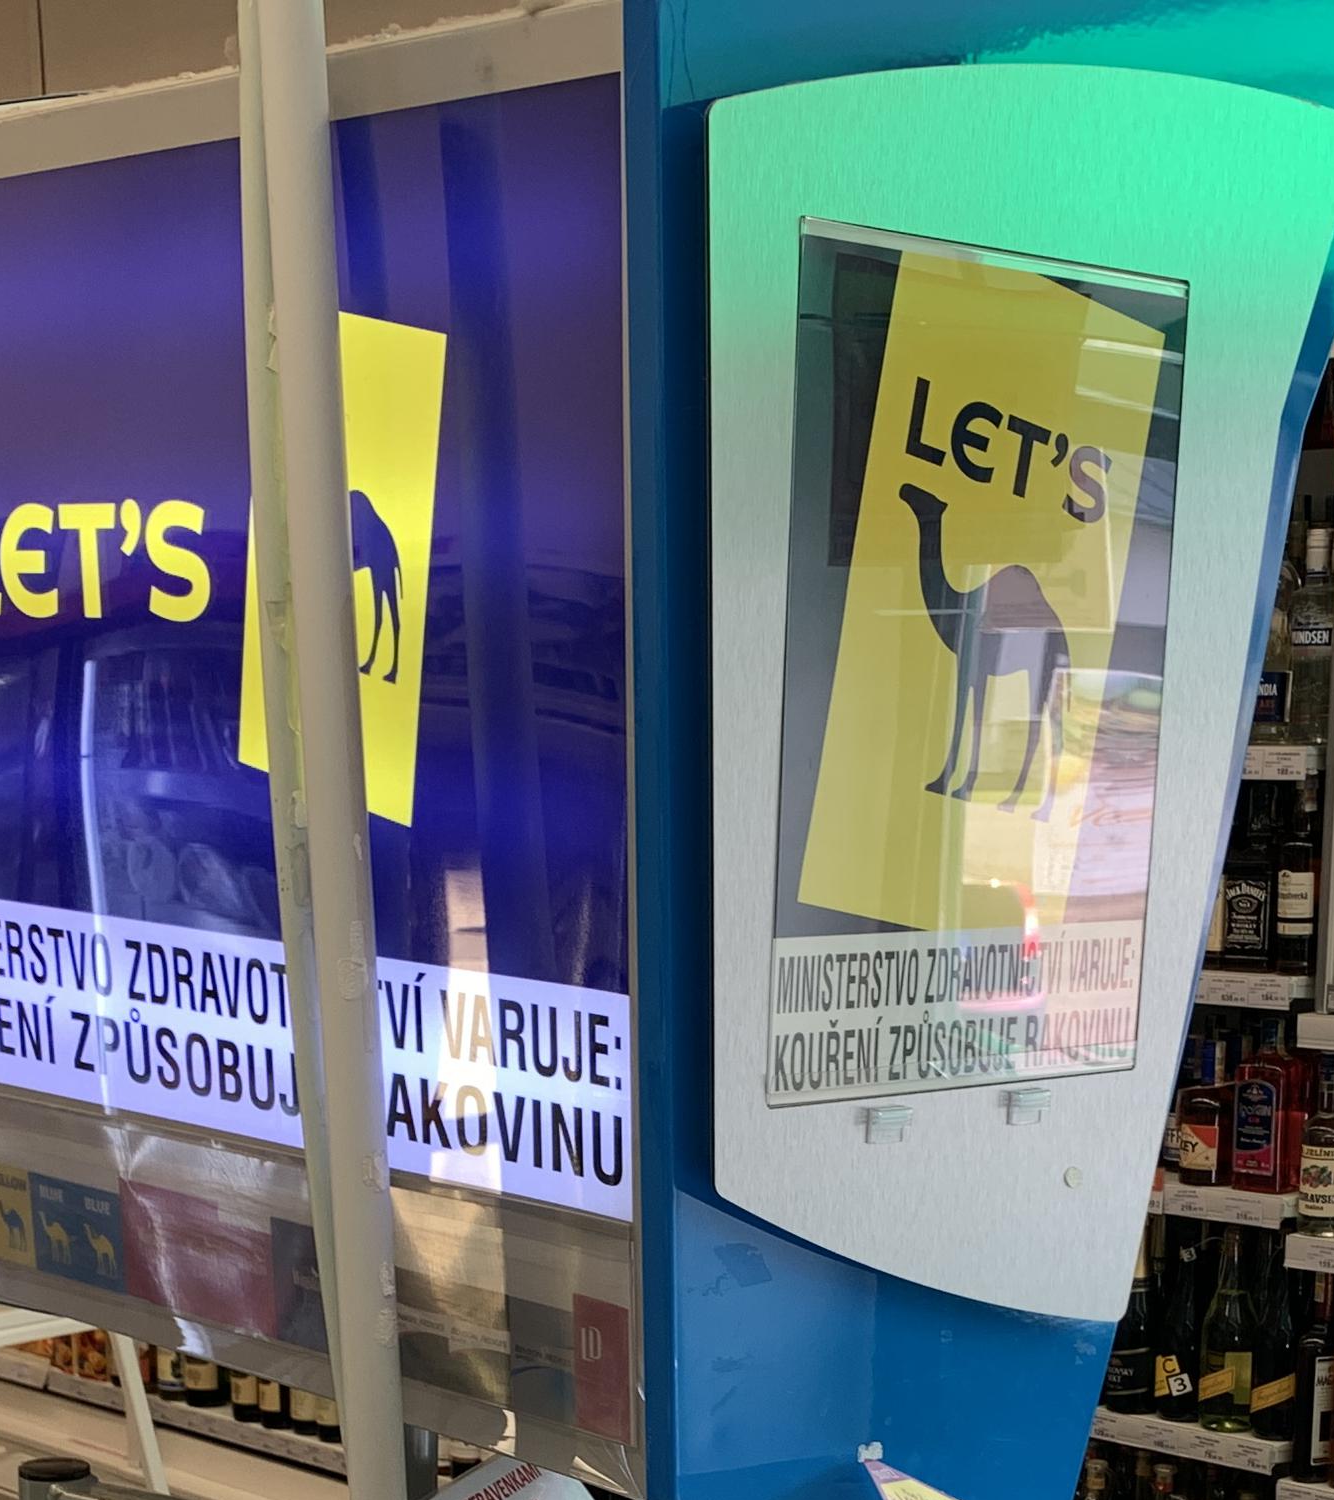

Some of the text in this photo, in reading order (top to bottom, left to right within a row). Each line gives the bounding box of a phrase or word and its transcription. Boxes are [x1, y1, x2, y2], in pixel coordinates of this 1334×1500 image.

[905, 376, 1113, 524] LET'S
[775, 948, 919, 1014] MINISTERSTVO
[1067, 937, 1136, 993] VARUJE:
[441, 990, 625, 1088] VARUJE:
[774, 1016, 884, 1092] KOUŘENÍ
[888, 1010, 1017, 1081] ZPŮSOBUJE
[74, 1008, 301, 1118] ZPŮSOBUJ
[387, 1074, 625, 1187] AKOVINU
[84, 1196, 111, 1216] BLUE
